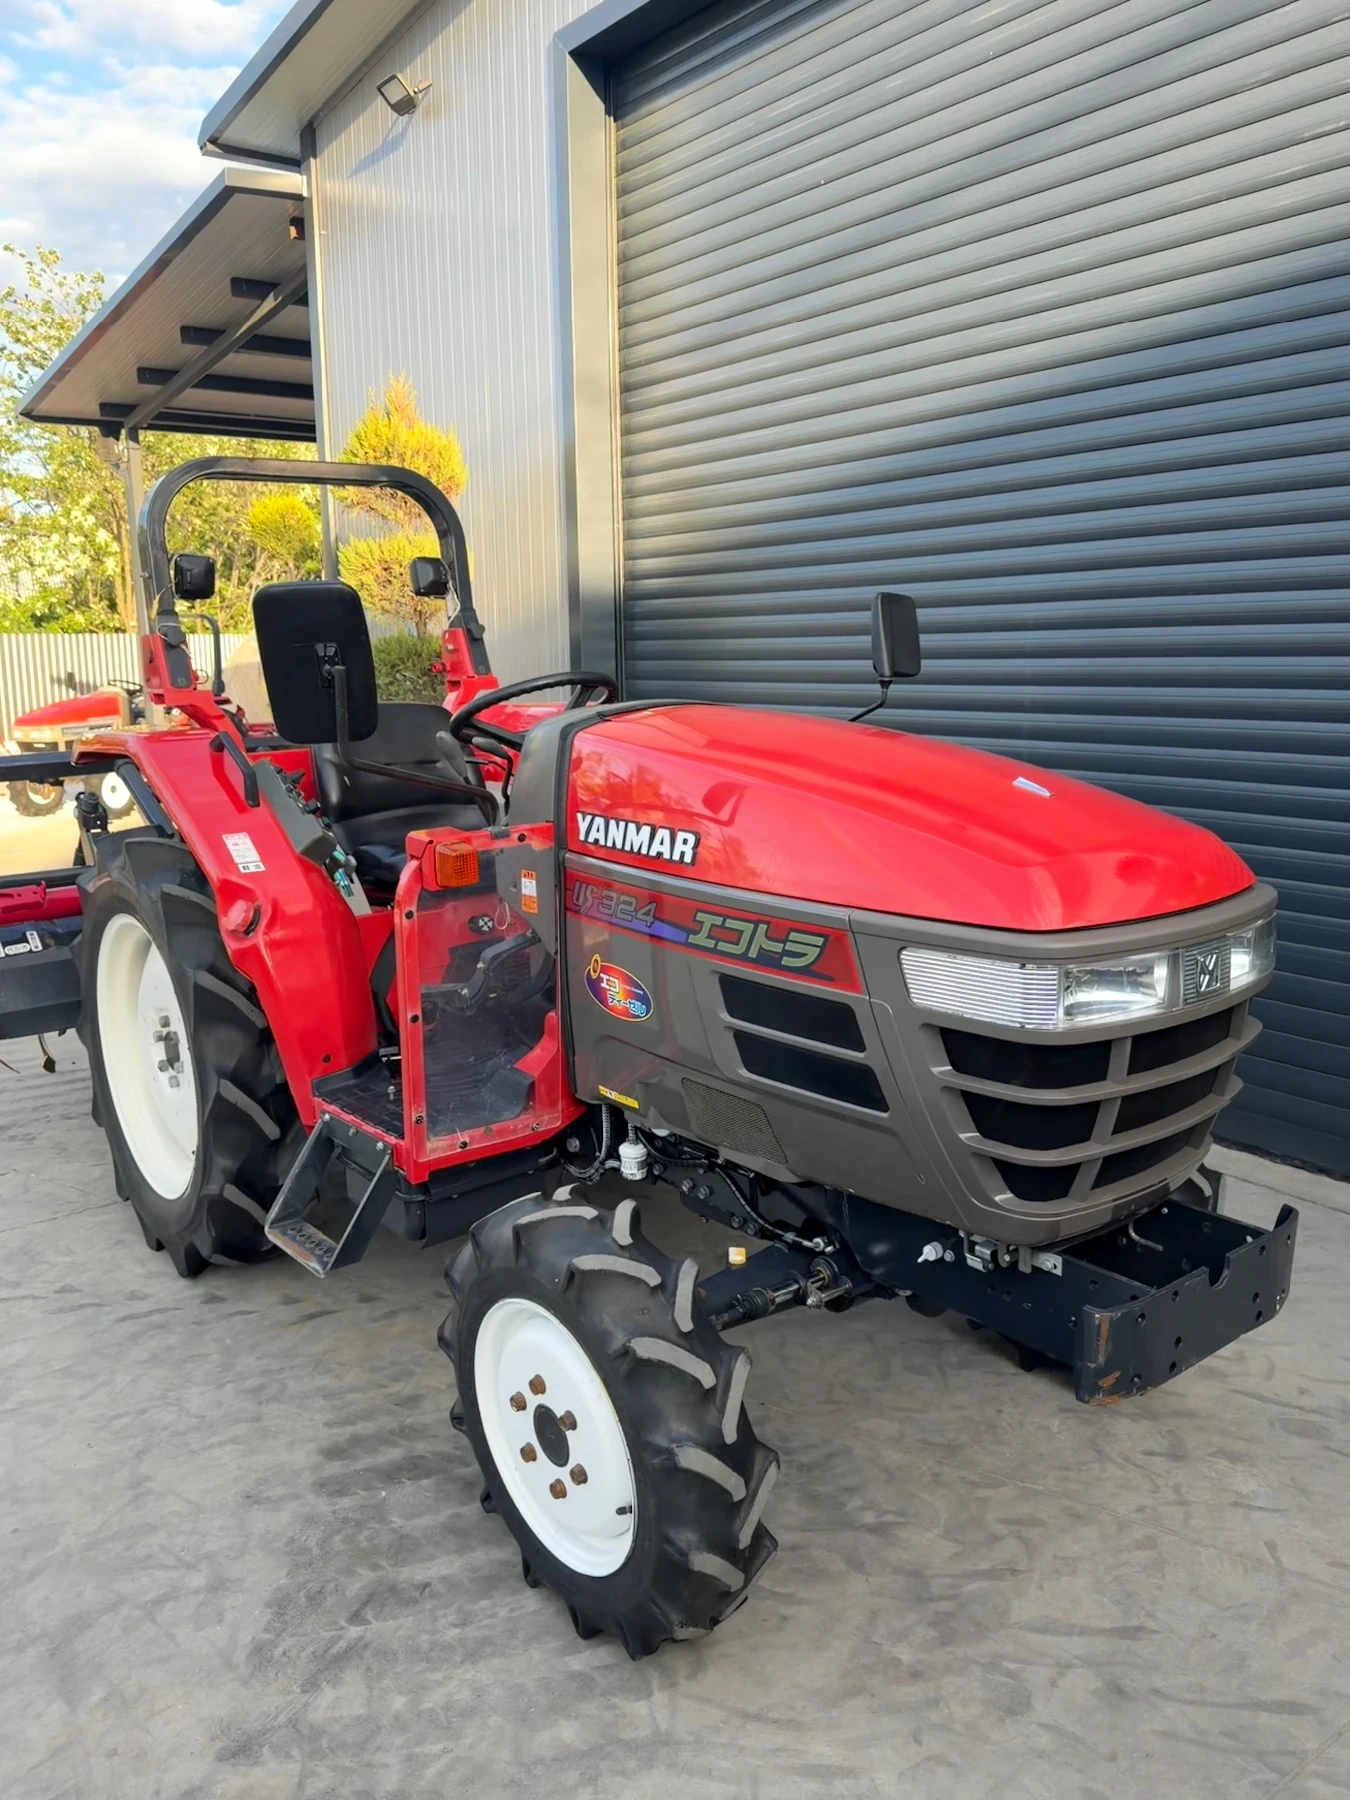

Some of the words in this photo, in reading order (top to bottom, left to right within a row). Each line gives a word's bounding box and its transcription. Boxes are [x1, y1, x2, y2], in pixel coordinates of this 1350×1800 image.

[576, 812, 697, 864] YANMAR
[687, 911, 825, 968] エコトラ
